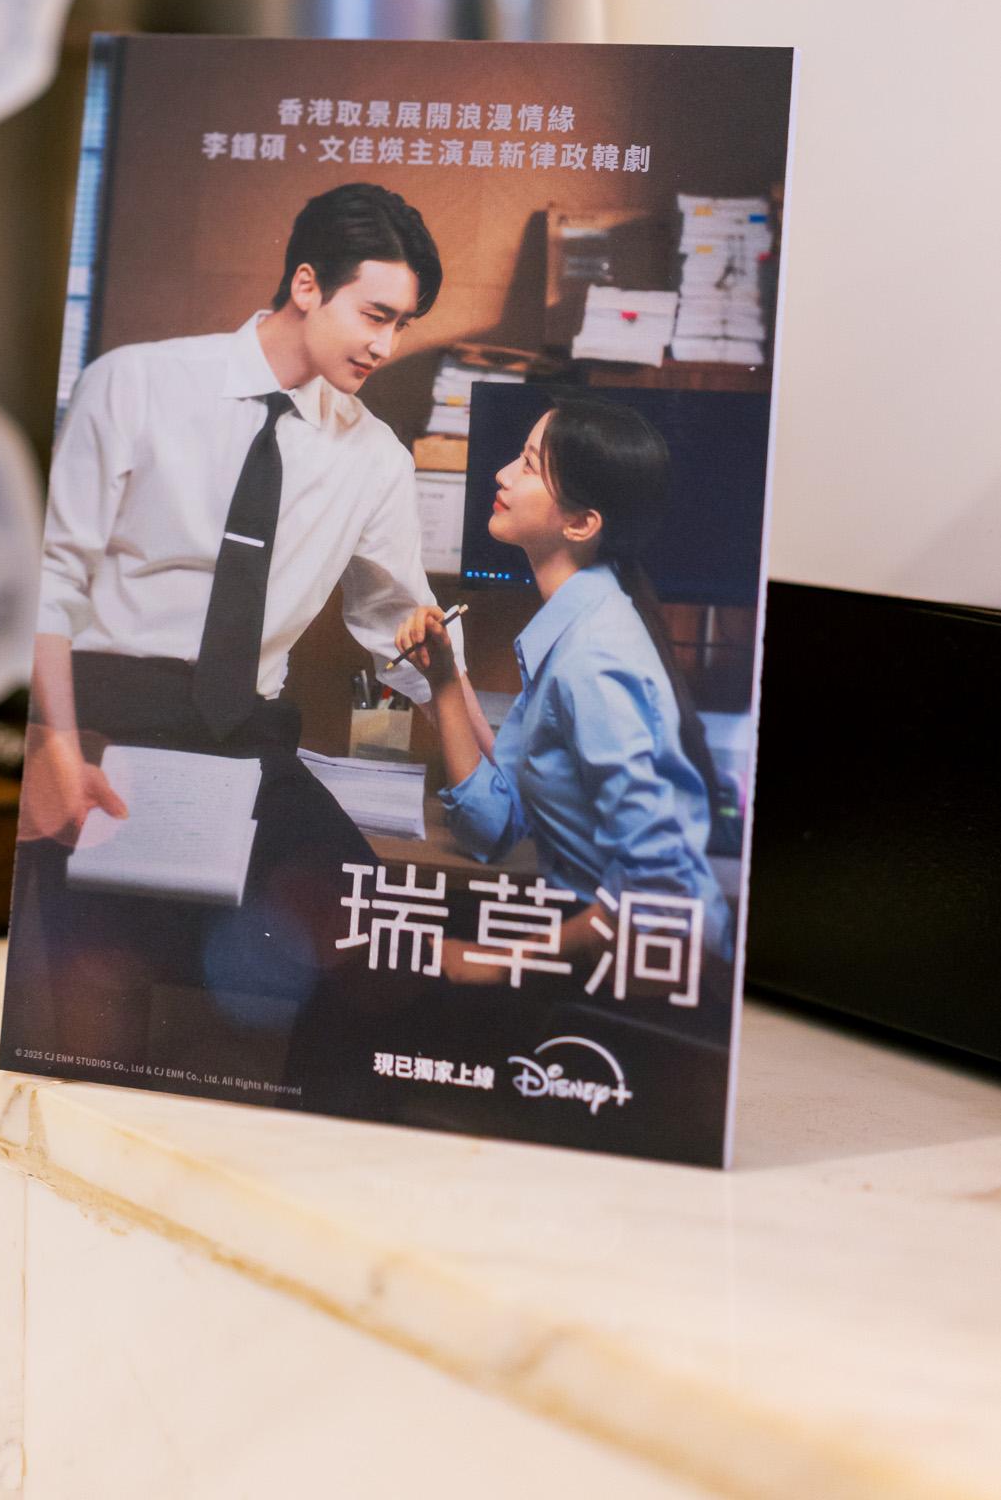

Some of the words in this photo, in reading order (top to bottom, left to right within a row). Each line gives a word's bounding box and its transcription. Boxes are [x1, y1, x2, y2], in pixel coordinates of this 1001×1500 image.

[278, 98, 576, 133] 香港取景展開浪漫情緣
[335, 862, 703, 1007] 瑞草洞
[23, 1049, 43, 1059] 2025
[44, 1052, 55, 1062] CJ
[56, 1053, 74, 1064] ENM
[154, 1066, 164, 1077] CJ
[166, 1068, 184, 1080] ENM
[204, 1073, 220, 1085] Ltd.
[221, 1076, 233, 1086] All
[235, 1078, 262, 1091] Rights
[263, 1082, 302, 1095] Reserved
[373, 1052, 495, 1090] 現已獨家上線
